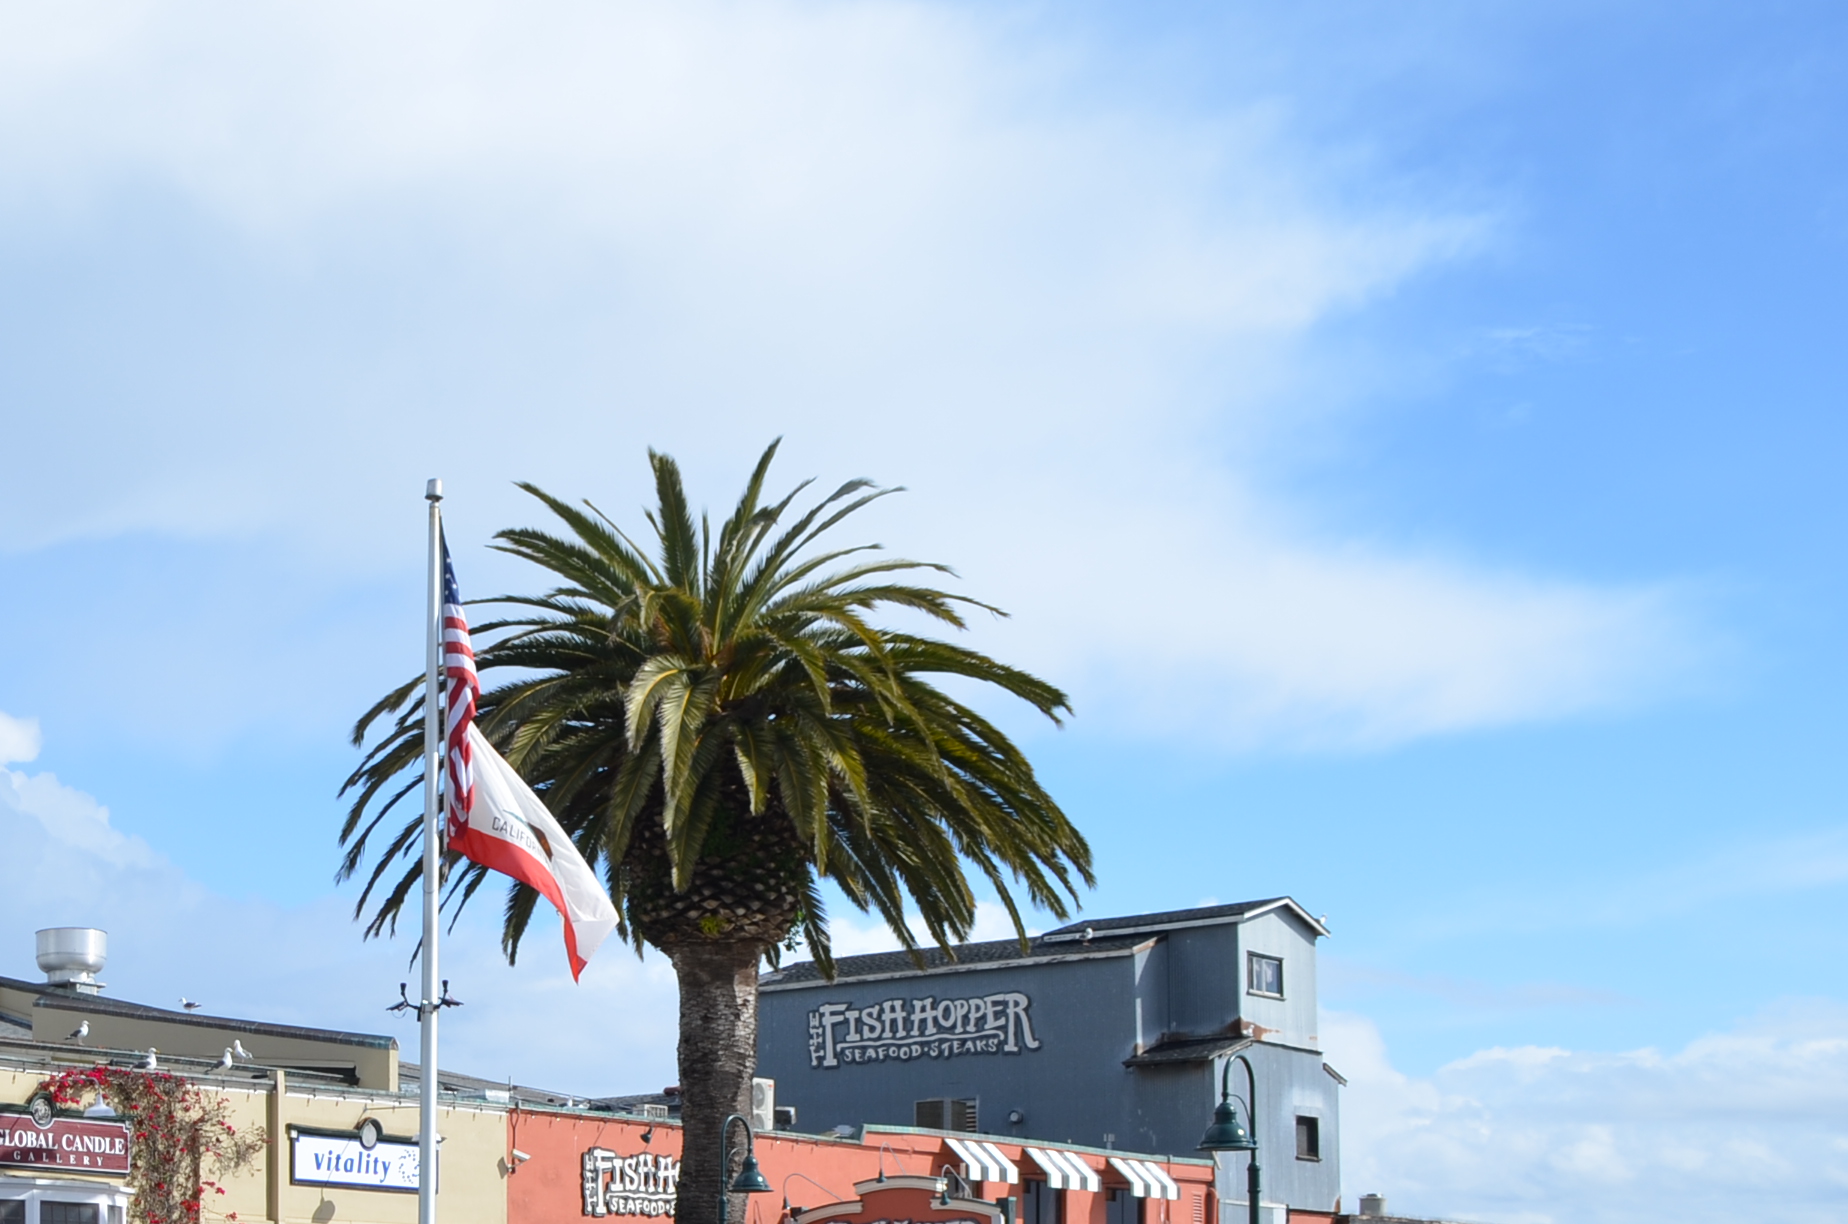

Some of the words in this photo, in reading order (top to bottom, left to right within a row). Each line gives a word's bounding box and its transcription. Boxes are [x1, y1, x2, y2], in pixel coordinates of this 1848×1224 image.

[809, 1013, 824, 1066] THE
[819, 999, 907, 1066] FISH
[911, 992, 1040, 1051] HOPPER
[843, 1046, 922, 1062] SEAFOOD
[929, 1038, 999, 1058] STEAKS
[13, 1150, 104, 1167] GALLERY
[61, 1133, 125, 1155] CANDLE
[314, 1150, 391, 1184] vitality
[585, 1153, 597, 1212] THE
[593, 1148, 655, 1214] FISH
[610, 1197, 664, 1216] SEAFOOD
